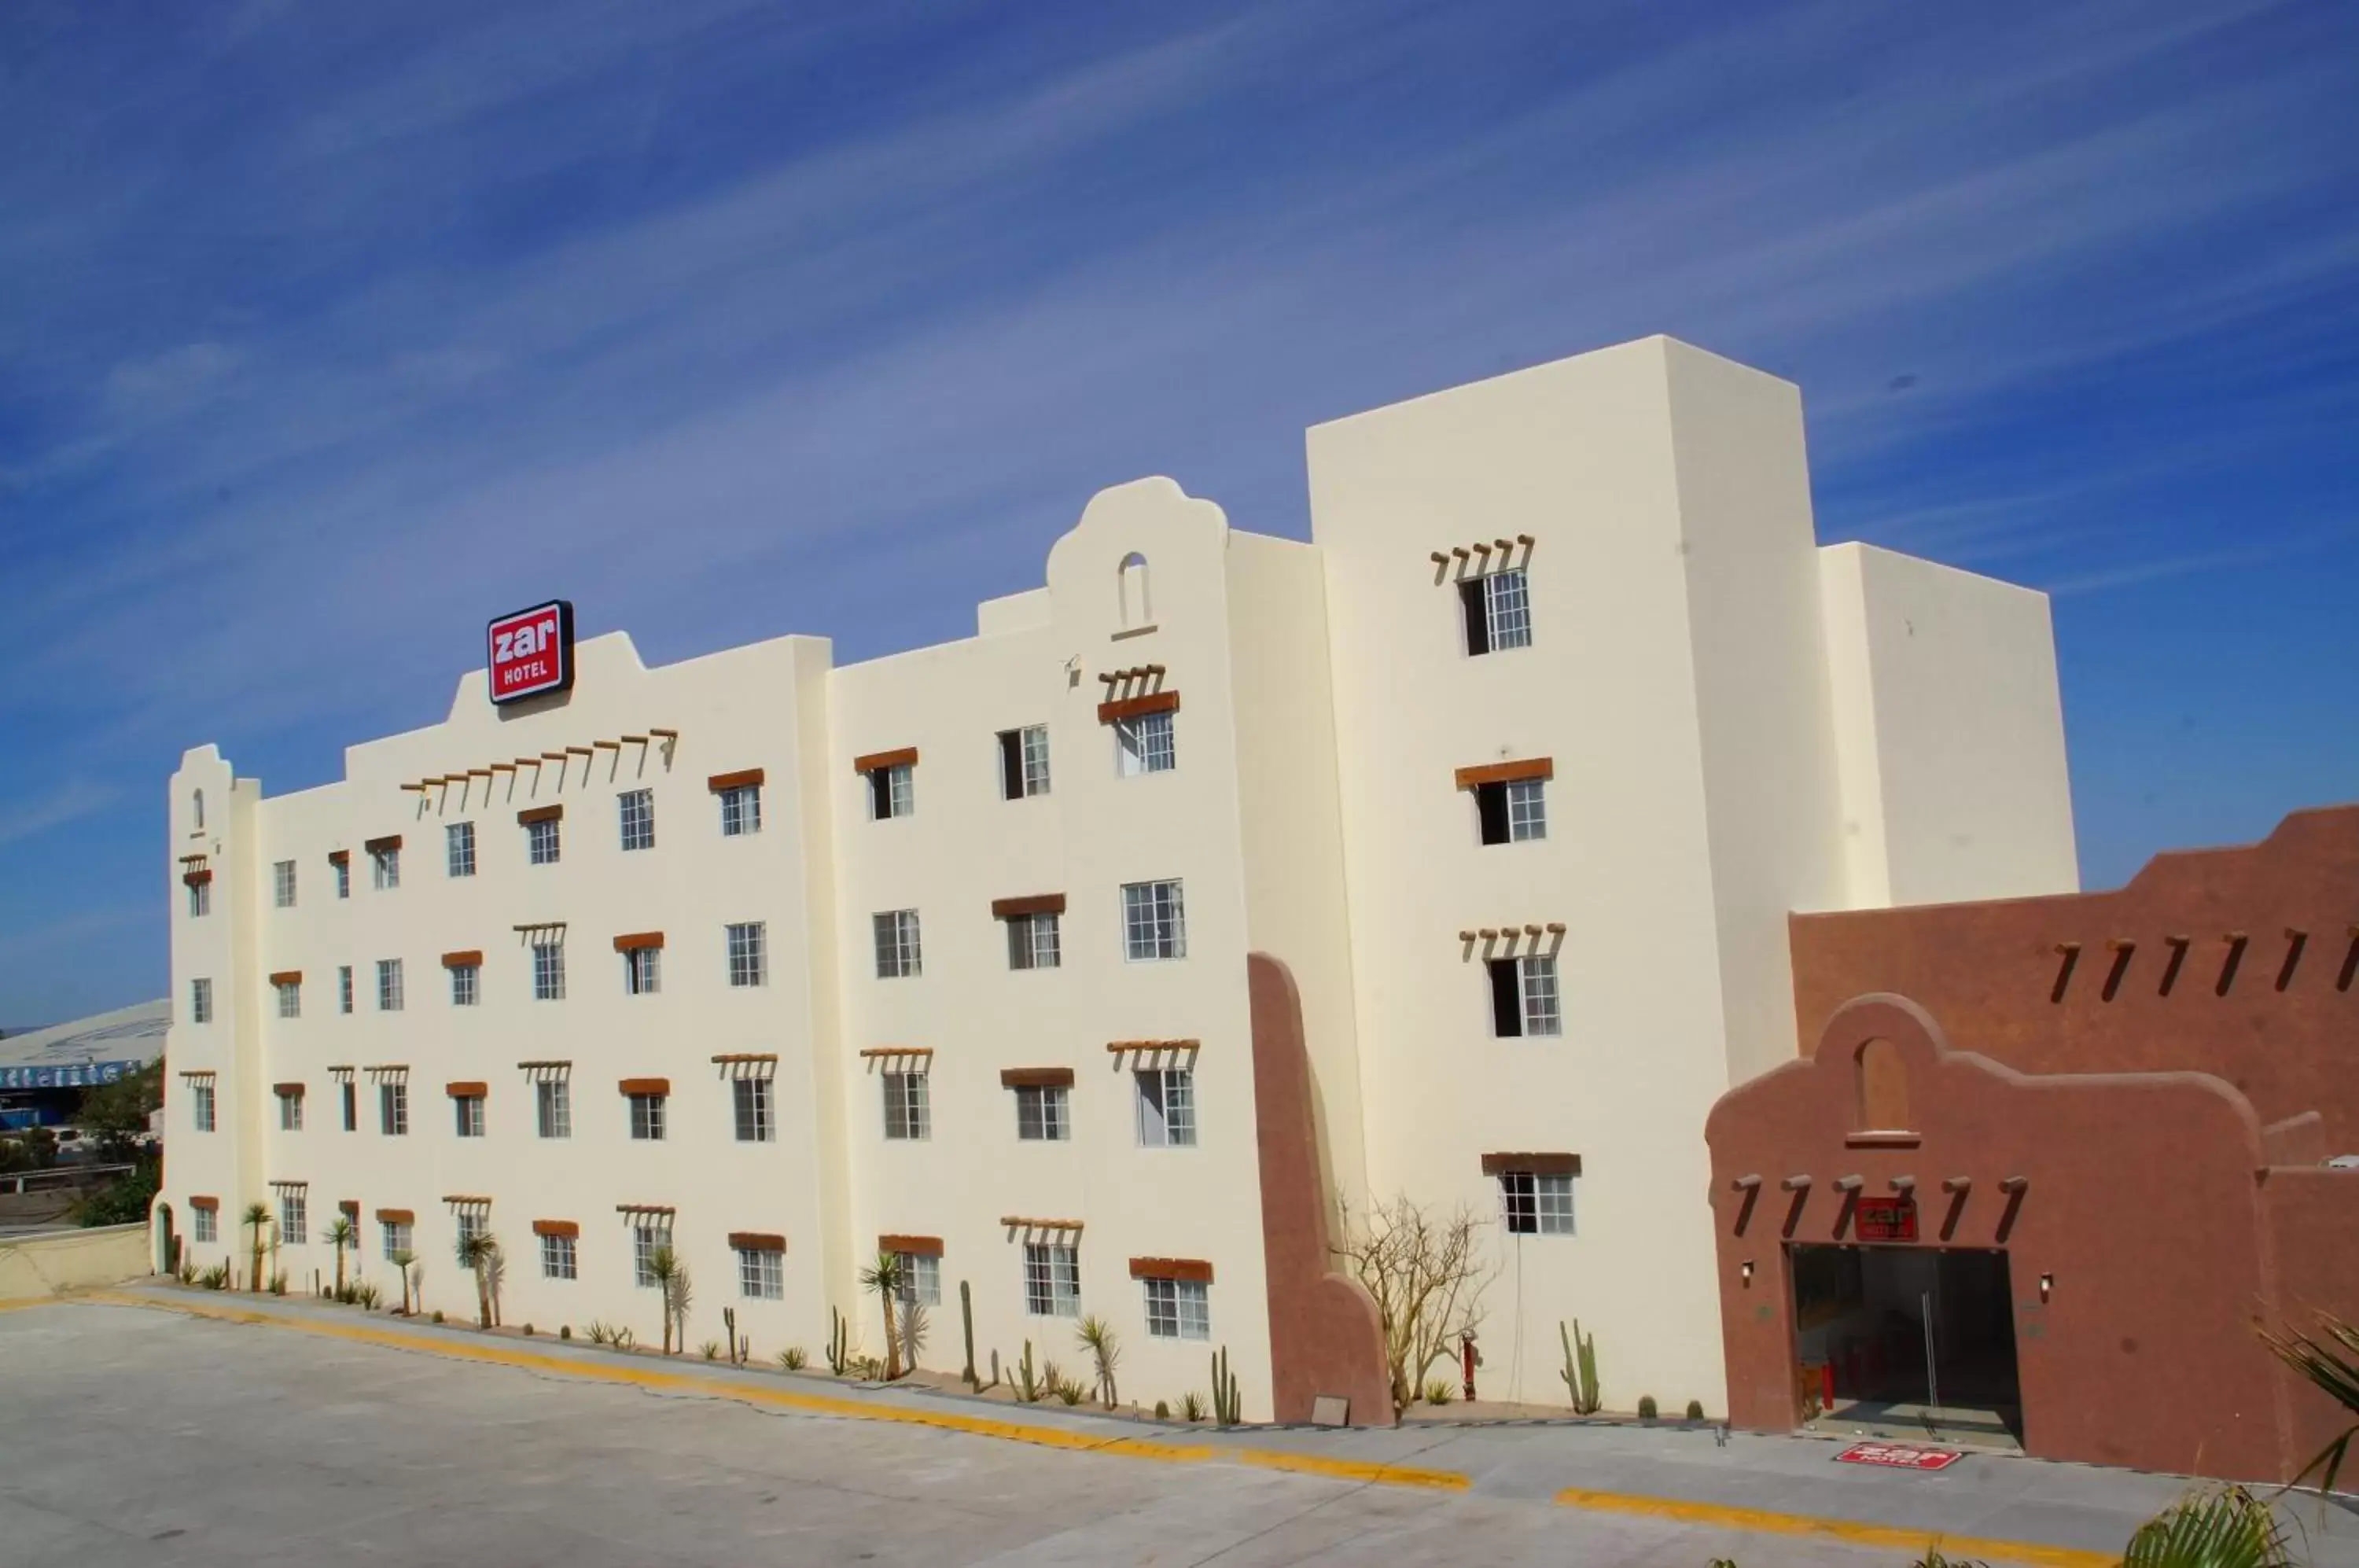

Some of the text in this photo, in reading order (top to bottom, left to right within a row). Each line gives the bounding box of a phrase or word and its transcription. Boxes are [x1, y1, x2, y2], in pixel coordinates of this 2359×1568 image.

[495, 619, 555, 664] zar
[504, 661, 548, 685] HOTEL
[1861, 1206, 1912, 1224] zar
